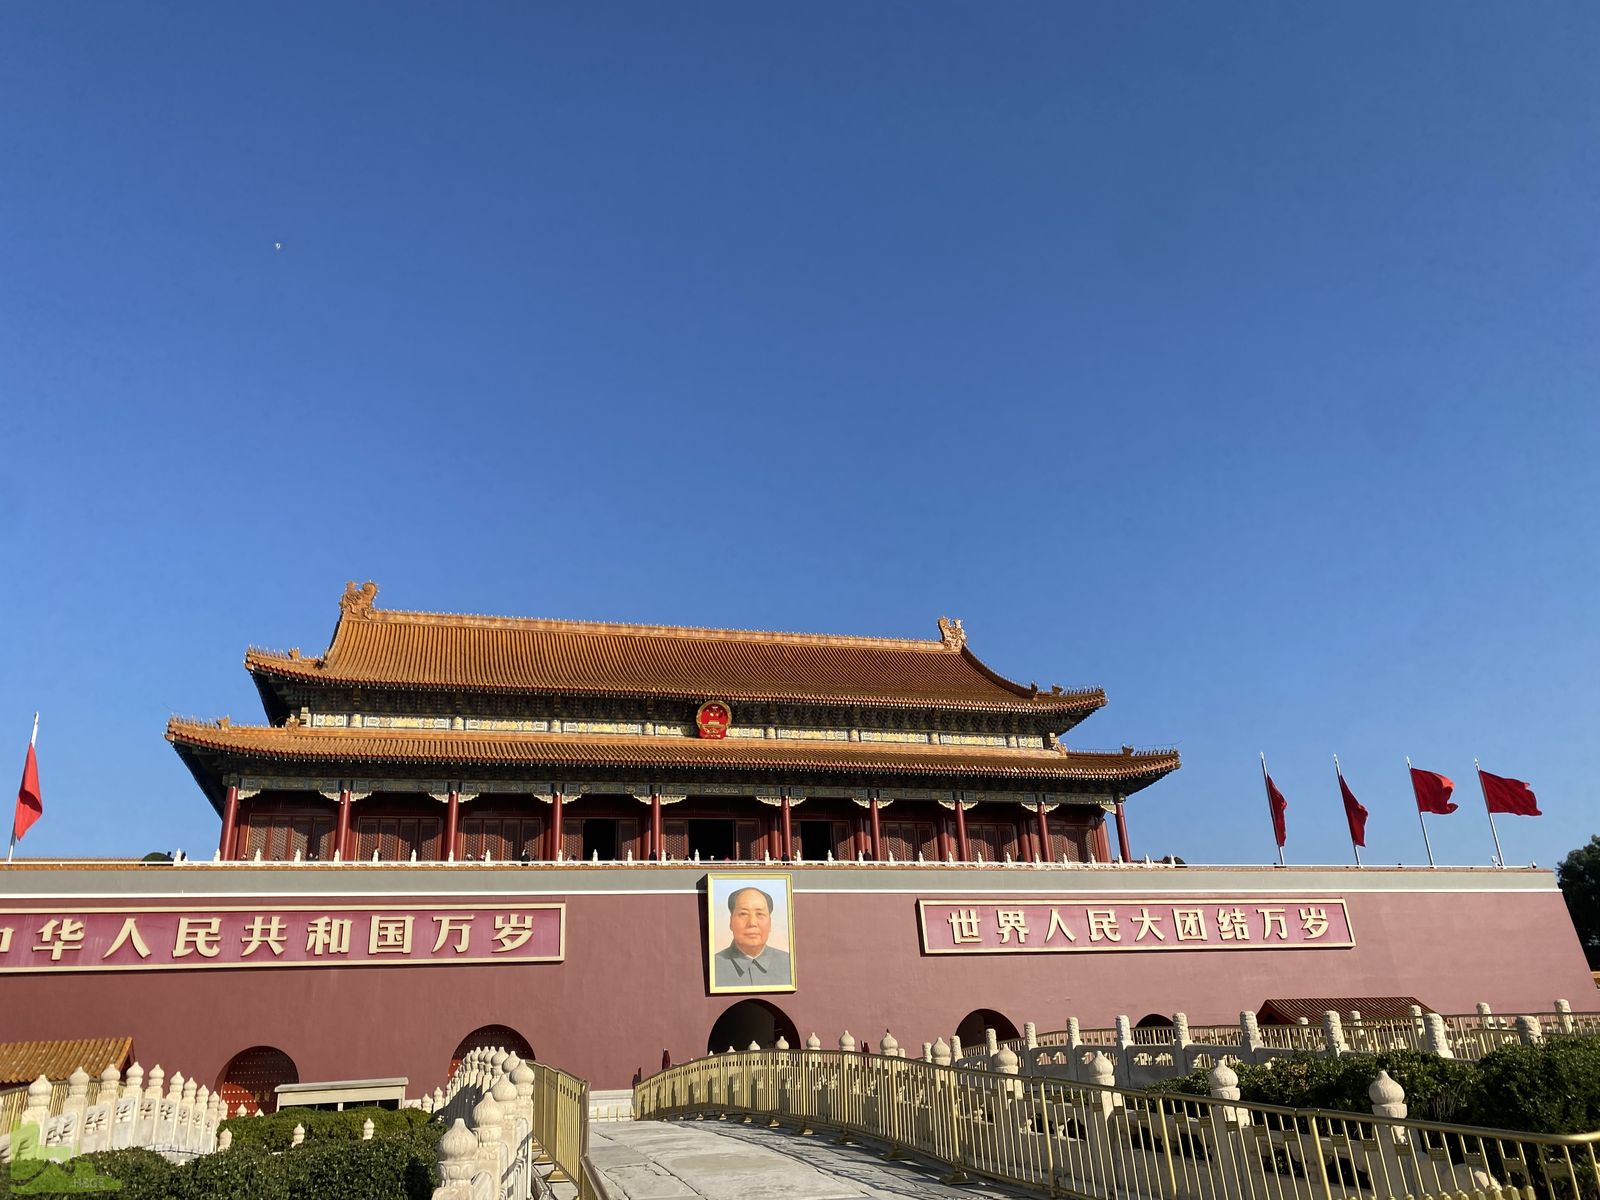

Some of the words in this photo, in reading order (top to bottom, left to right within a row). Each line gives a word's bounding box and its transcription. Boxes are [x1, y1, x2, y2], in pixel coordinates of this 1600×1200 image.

[947, 907, 1329, 944] 世界人民大团结万岁
